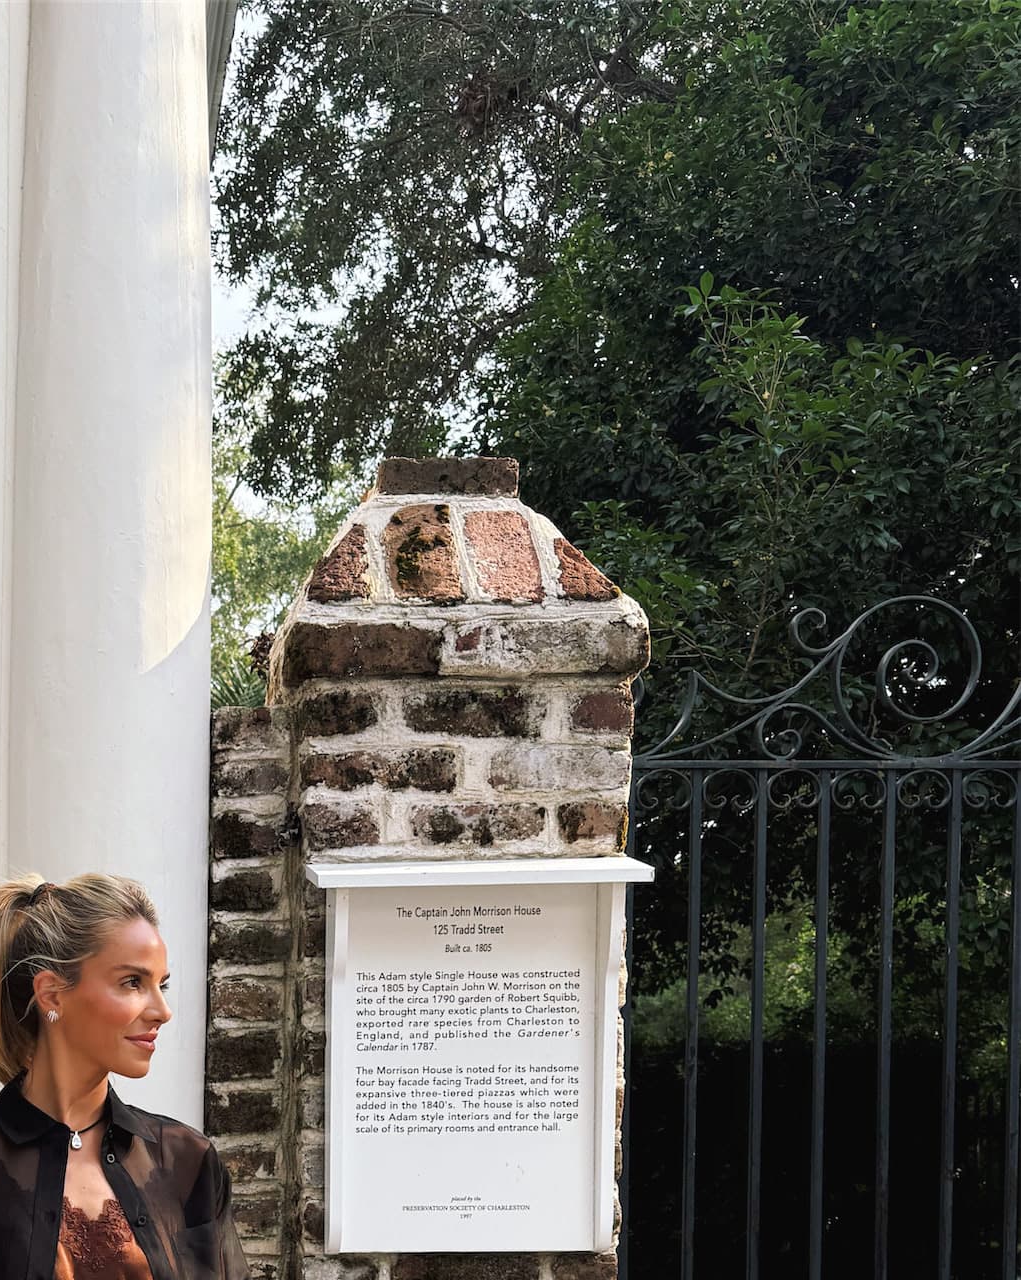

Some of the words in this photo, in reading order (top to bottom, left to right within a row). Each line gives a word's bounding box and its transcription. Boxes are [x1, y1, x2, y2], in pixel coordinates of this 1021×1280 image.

[396, 907, 412, 918] The
[415, 906, 448, 920] Captain
[450, 906, 471, 917] John
[473, 905, 511, 916] Morrison
[514, 905, 541, 916] House
[433, 925, 449, 935] 125
[450, 924, 475, 935] Tradd
[477, 924, 504, 934] Street
[445, 944, 461, 953] Built
[475, 943, 492, 952] 1805
[356, 972, 376, 980] This
[378, 972, 406, 980] Adam
[410, 971, 432, 982] style
[435, 971, 465, 981] Single
[468, 971, 498, 979] House
[523, 969, 580, 978] constructed
[356, 984, 378, 992] circa
[382, 984, 404, 992] 1805
[408, 984, 418, 994] by
[422, 983, 458, 994] Captain
[461, 983, 485, 991] John
[503, 982, 546, 990] Morrison
[564, 981, 580, 989] the
[356, 996, 373, 1004] site
[376, 995, 386, 1004] of
[388, 996, 404, 1004] the
[407, 996, 429, 1004] circa
[432, 995, 455, 1003] 1790
[458, 994, 491, 1005] garden
[494, 993, 505, 1002] of
[508, 993, 540, 1002] Robert
[543, 993, 580, 1003] Squibb,
[356, 1008, 376, 1016] who
[379, 1007, 417, 1017] brought
[419, 1009, 445, 1017] many
[448, 1006, 477, 1015] exotic
[480, 1006, 509, 1016] plants
[525, 1005, 580, 1014] Charleston,
[356, 1019, 403, 1030] exported
[434, 1018, 472, 1029] species
[478, 1017, 502, 1026] from
[507, 1016, 564, 1025] Charleston
[356, 1031, 403, 1041] England,
[410, 1030, 429, 1039] and
[434, 1029, 488, 1040] published
[494, 1029, 511, 1038] the
[518, 1029, 580, 1038] Gardener's
[356, 1043, 398, 1051] Calendar
[400, 1043, 408, 1051] in
[412, 1042, 437, 1051] 1787.
[356, 1066, 373, 1075] The
[377, 1066, 419, 1075] Morrison
[422, 1065, 453, 1074] House
[456, 1065, 463, 1073] is
[466, 1064, 494, 1073] noted
[498, 1064, 512, 1073] for
[515, 1065, 526, 1073] its
[529, 1064, 579, 1072] handsome
[356, 1077, 375, 1086] four
[378, 1077, 395, 1088] bay
[398, 1077, 429, 1086] facade
[433, 1076, 461, 1087] facing
[465, 1076, 492, 1085] Tradd
[495, 1076, 527, 1085] Street,
[530, 1076, 547, 1084] and
[551, 1075, 564, 1084] for
[568, 1075, 579, 1084] its
[356, 1090, 406, 1100] expansive
[411, 1089, 473, 1097] three-tiered
[478, 1088, 515, 1099] piazzas
[520, 1088, 549, 1096] which
[356, 1101, 386, 1110] added
[390, 1101, 398, 1109] in
[402, 1101, 417, 1109] the
[422, 1100, 455, 1109] 1840's.
[462, 1100, 480, 1109] The
[484, 1100, 512, 1108] house
[516, 1100, 523, 1108] is
[527, 1099, 546, 1108] also
[550, 1099, 579, 1108] noted
[356, 1113, 369, 1121] for
[373, 1113, 385, 1121] its
[389, 1113, 417, 1121] Adam
[421, 1112, 444, 1123] style
[448, 1111, 489, 1120] interiors
[493, 1111, 512, 1120] and
[515, 1111, 529, 1120] for
[533, 1111, 549, 1120] the
[553, 1111, 579, 1121] large
[355, 1124, 378, 1133] scale
[381, 1124, 391, 1133] of
[394, 1124, 405, 1133] its
[408, 1124, 442, 1135] primary
[477, 1123, 495, 1132] and
[541, 1122, 561, 1131] hall.
